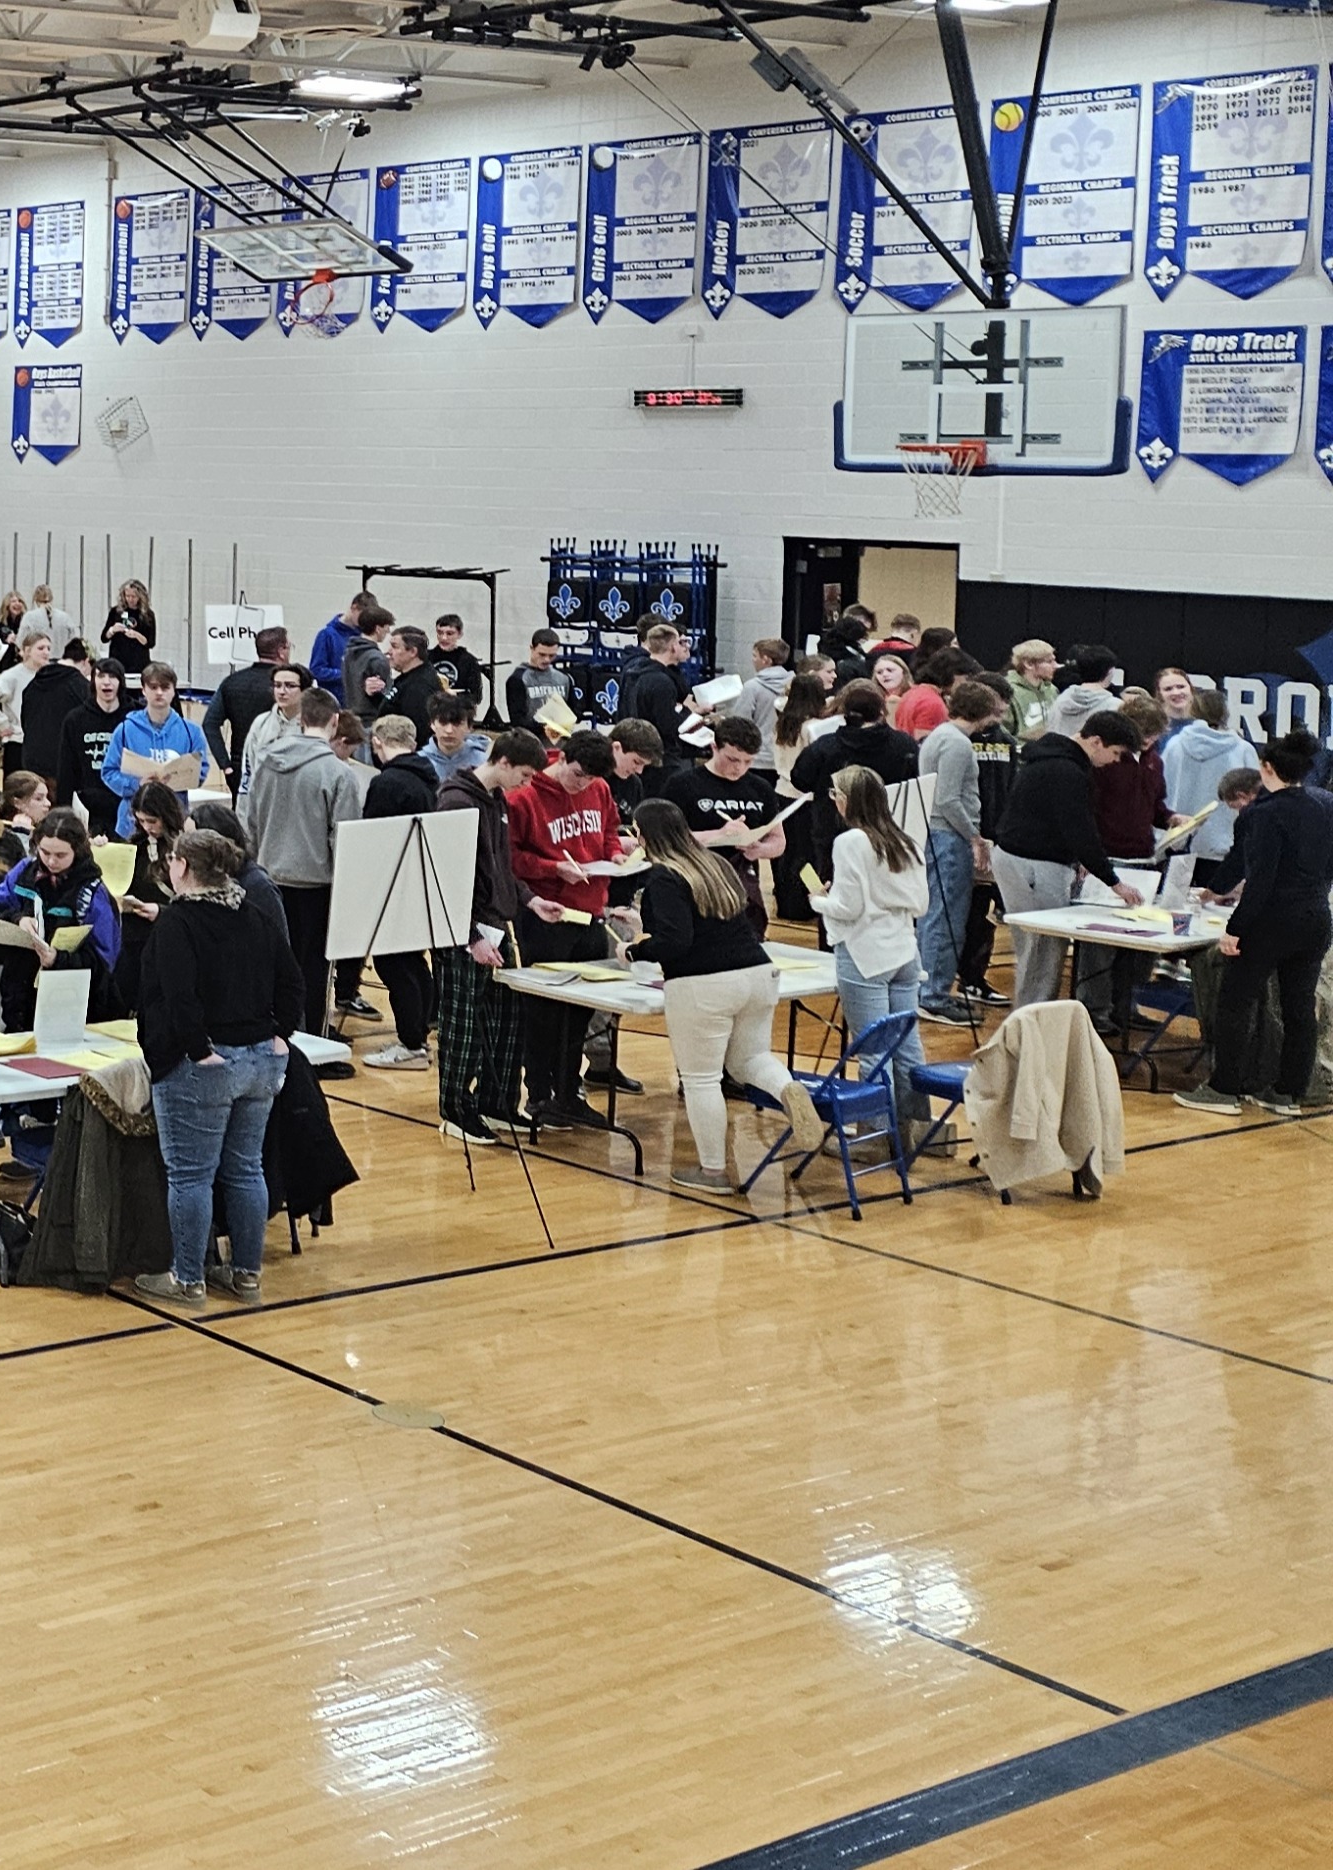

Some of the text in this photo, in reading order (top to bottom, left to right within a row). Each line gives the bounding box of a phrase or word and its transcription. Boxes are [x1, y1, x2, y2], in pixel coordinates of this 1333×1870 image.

[1094, 88, 1131, 99] CHAMPS
[1257, 86, 1281, 96] 1960
[937, 106, 957, 117] CHA
[1058, 107, 1079, 116] 2001
[1195, 103, 1219, 112] 1970
[1226, 100, 1249, 109] 1971
[1288, 105, 1312, 114] 2014
[1157, 154, 1180, 204] Track
[1205, 165, 1295, 180] REGIONAL CHAMPS
[1039, 180, 1122, 193] REGIONAL CHAMPS
[593, 214, 608, 246] Golf
[1156, 207, 1178, 250] Boys
[1201, 221, 1294, 235] SECTIONAL CHAMPS
[482, 223, 497, 253] Golf
[845, 211, 866, 268] Soccer
[1035, 232, 1121, 245] SECTIONAL CHAMPS
[712, 220, 731, 275] Hockey
[591, 247, 607, 282] Girls
[480, 255, 495, 289] Boys
[1191, 331, 1298, 352] Boys Track
[1189, 351, 1296, 363] STATE CHAMPIONSHIPS
[208, 627, 234, 639] Cell
[713, 800, 764, 812] ARIAT
